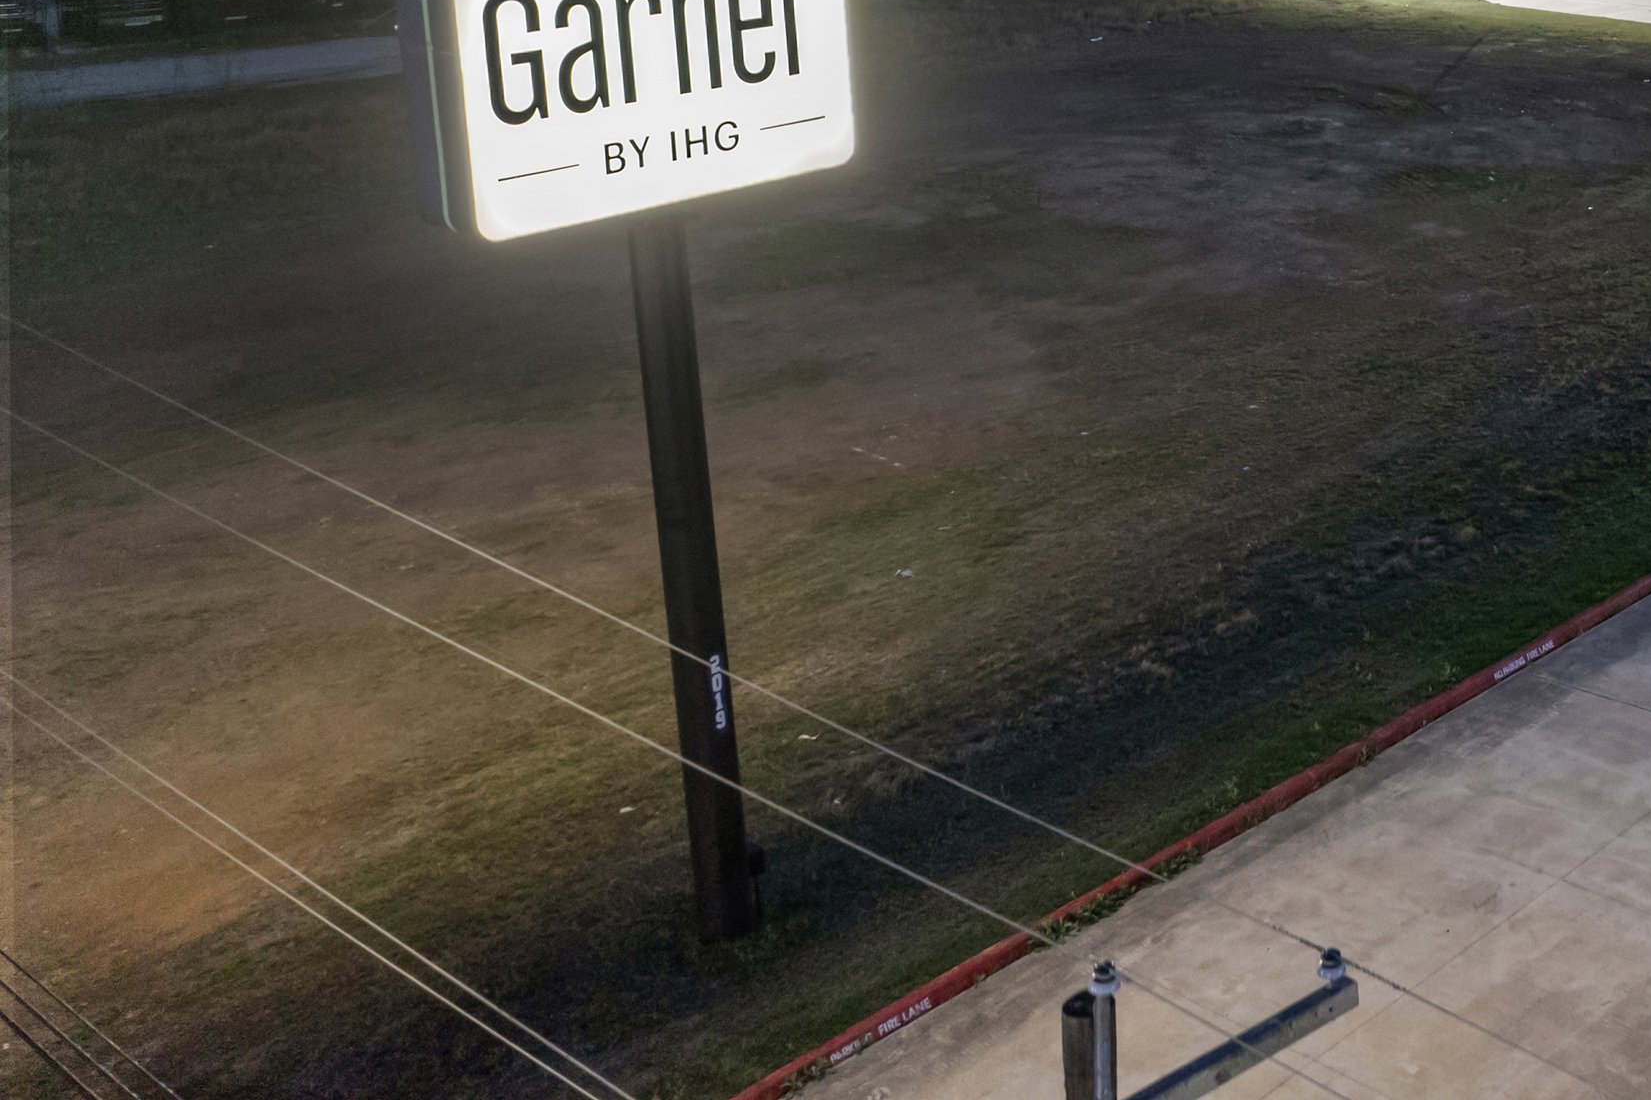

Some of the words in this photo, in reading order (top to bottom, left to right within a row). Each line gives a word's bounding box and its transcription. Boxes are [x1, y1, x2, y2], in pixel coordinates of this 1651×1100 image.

[604, 136, 650, 175] BY
[669, 120, 741, 162] IHG
[1538, 640, 1554, 653] LANE
[830, 1032, 873, 1063] PARKIG
[878, 1016, 901, 1036] FIRE
[902, 997, 931, 1020] LANE
